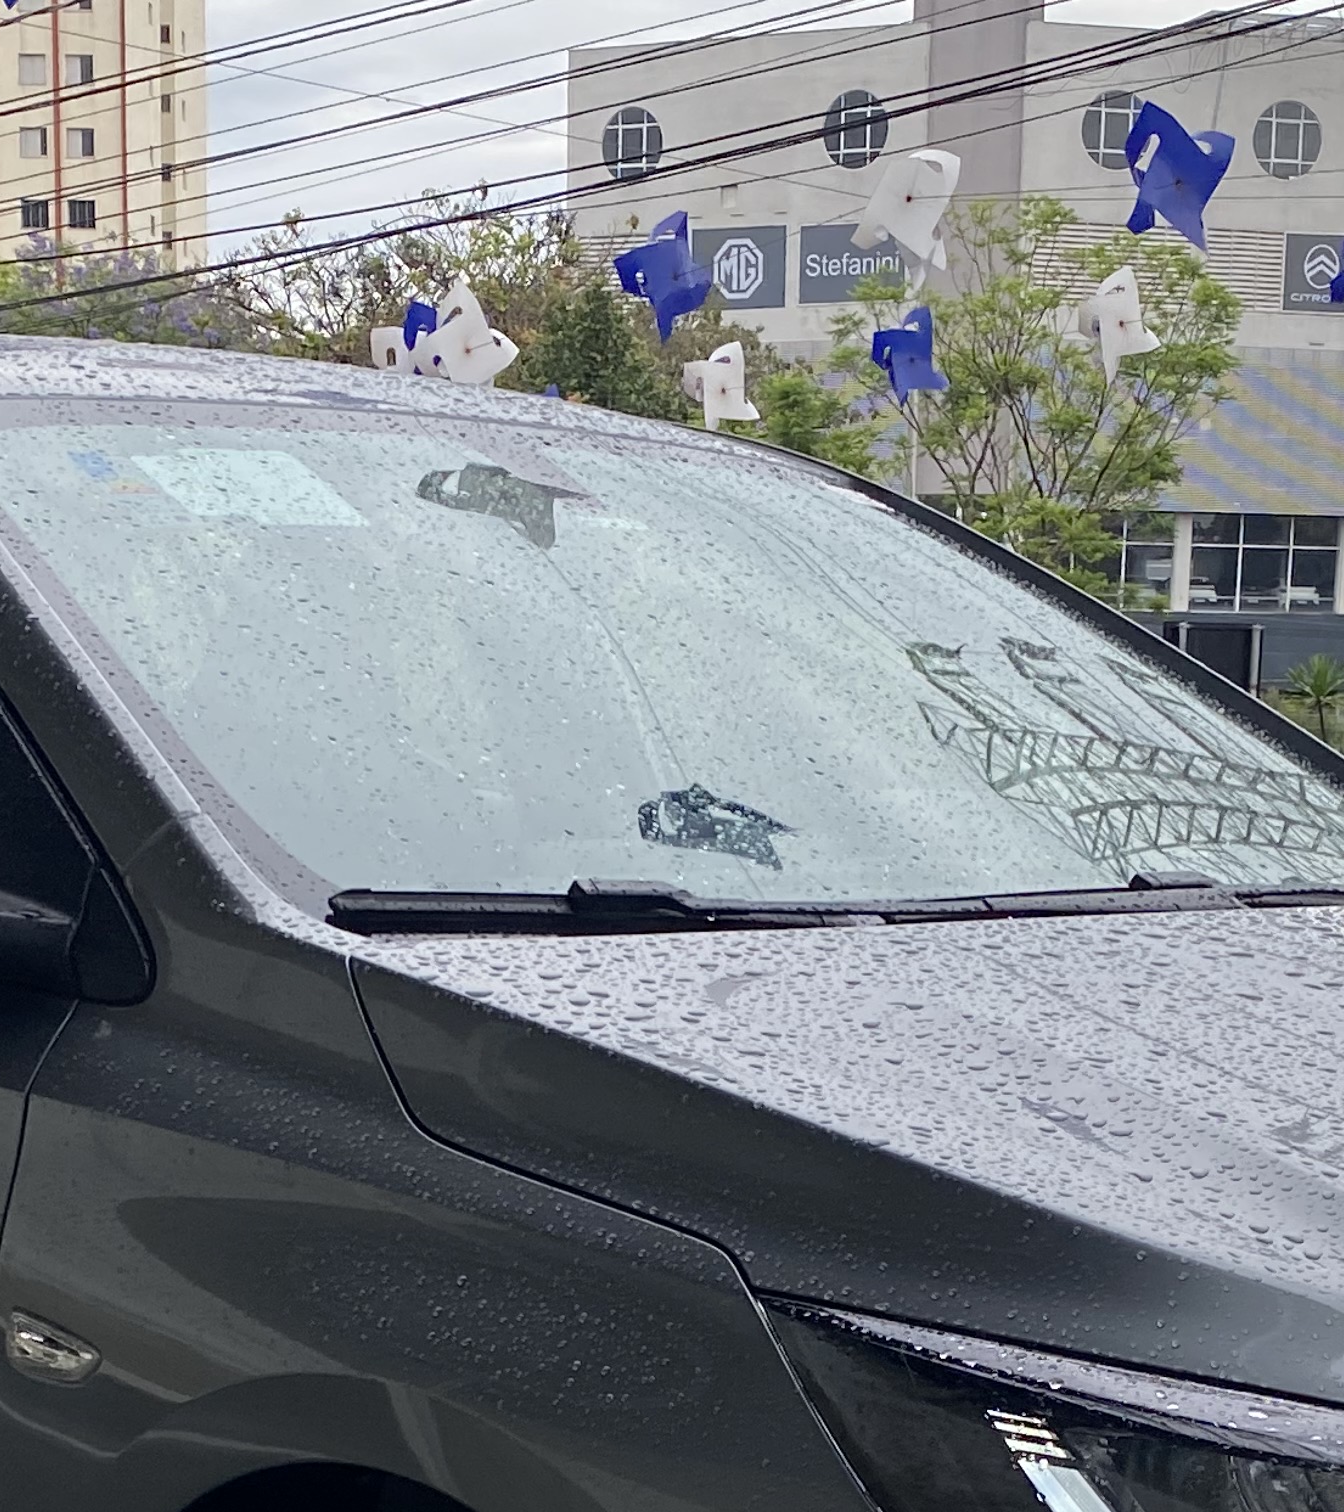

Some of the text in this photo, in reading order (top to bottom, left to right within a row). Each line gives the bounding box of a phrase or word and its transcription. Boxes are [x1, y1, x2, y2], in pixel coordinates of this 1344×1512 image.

[719, 246, 757, 292] MG
[805, 251, 901, 277] Stefanini
[1290, 292, 1331, 303] CITRO
